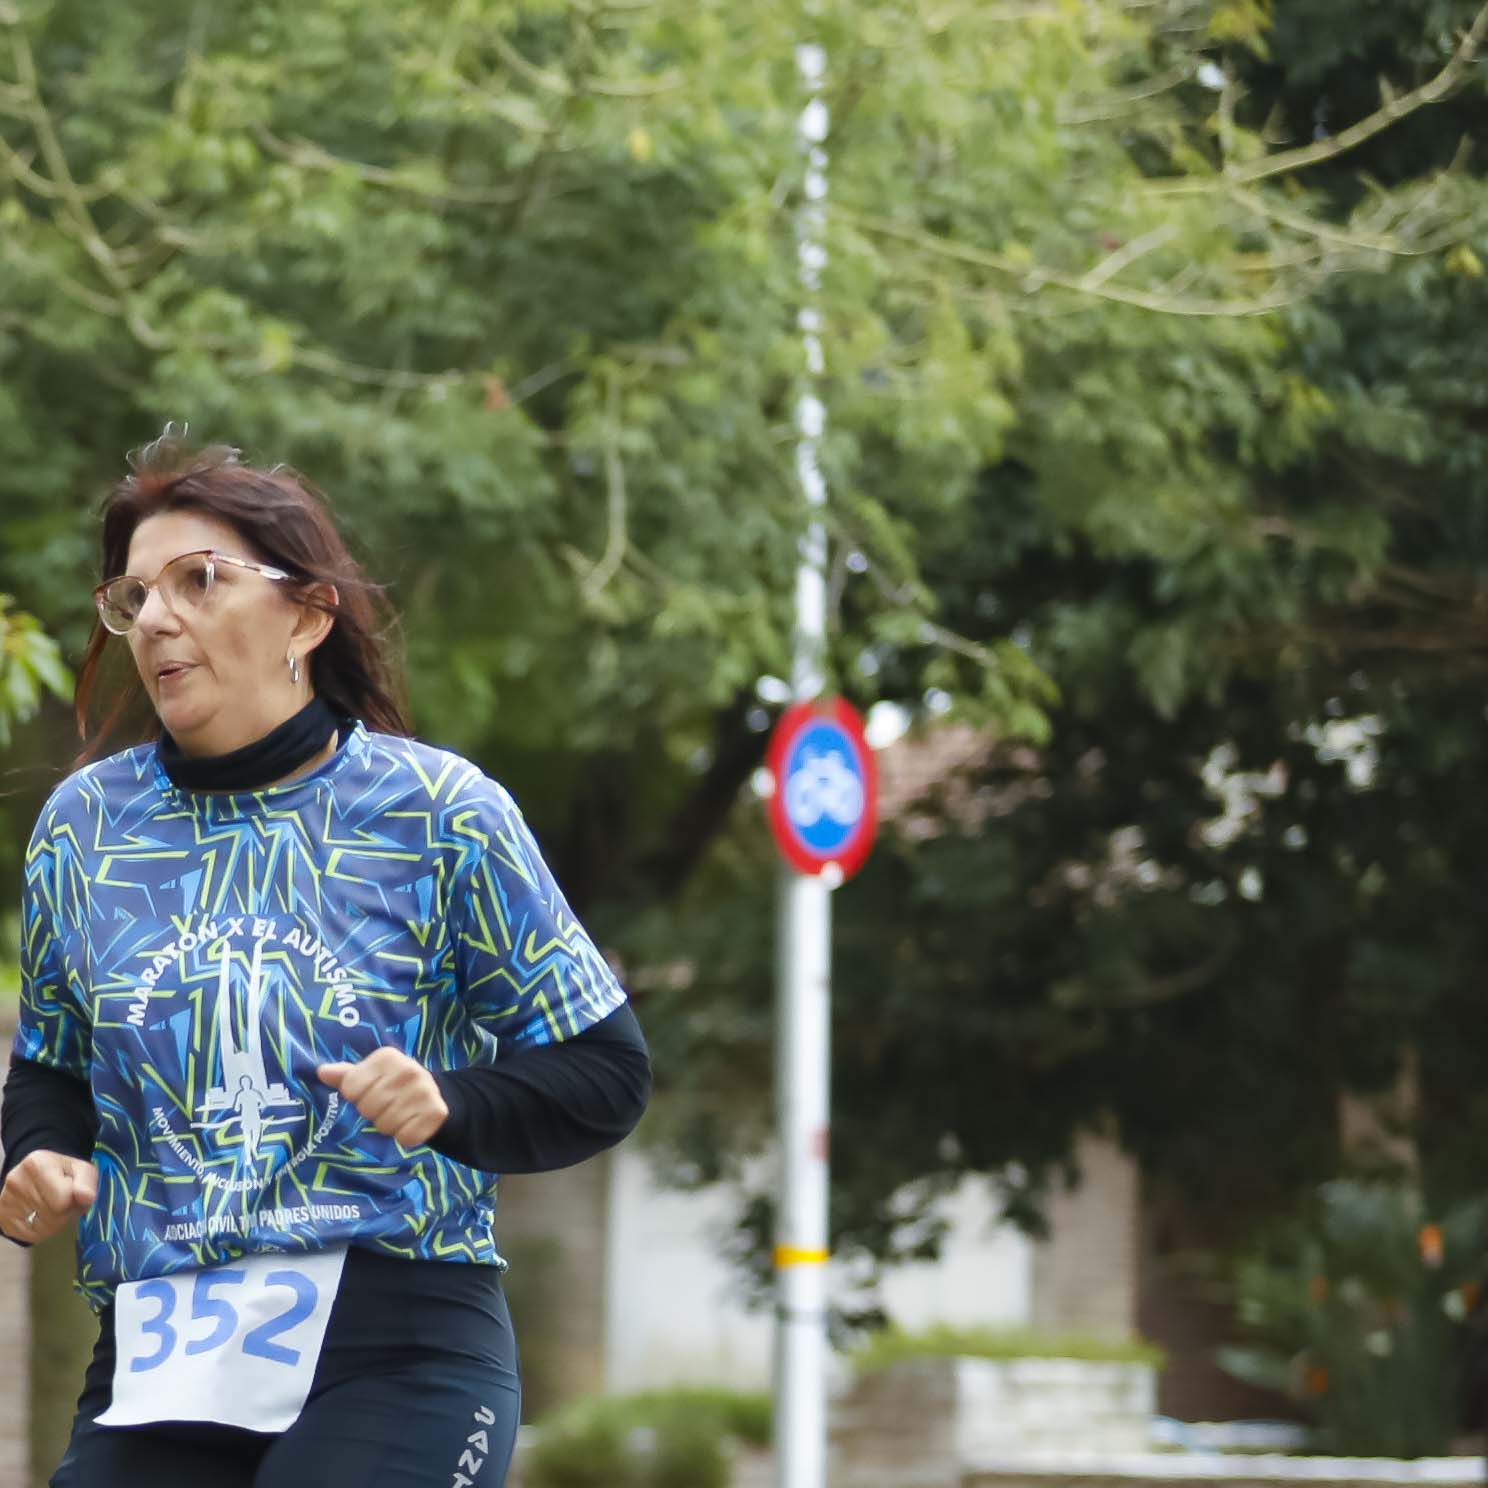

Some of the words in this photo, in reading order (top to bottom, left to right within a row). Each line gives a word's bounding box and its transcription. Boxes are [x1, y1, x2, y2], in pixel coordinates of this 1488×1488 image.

[227, 917, 245, 937] X
[252, 918, 278, 940] EL
[282, 928, 360, 1028] AUTISMO
[310, 1203, 361, 1222] UNIDOS
[130, 1267, 319, 1373] 352
